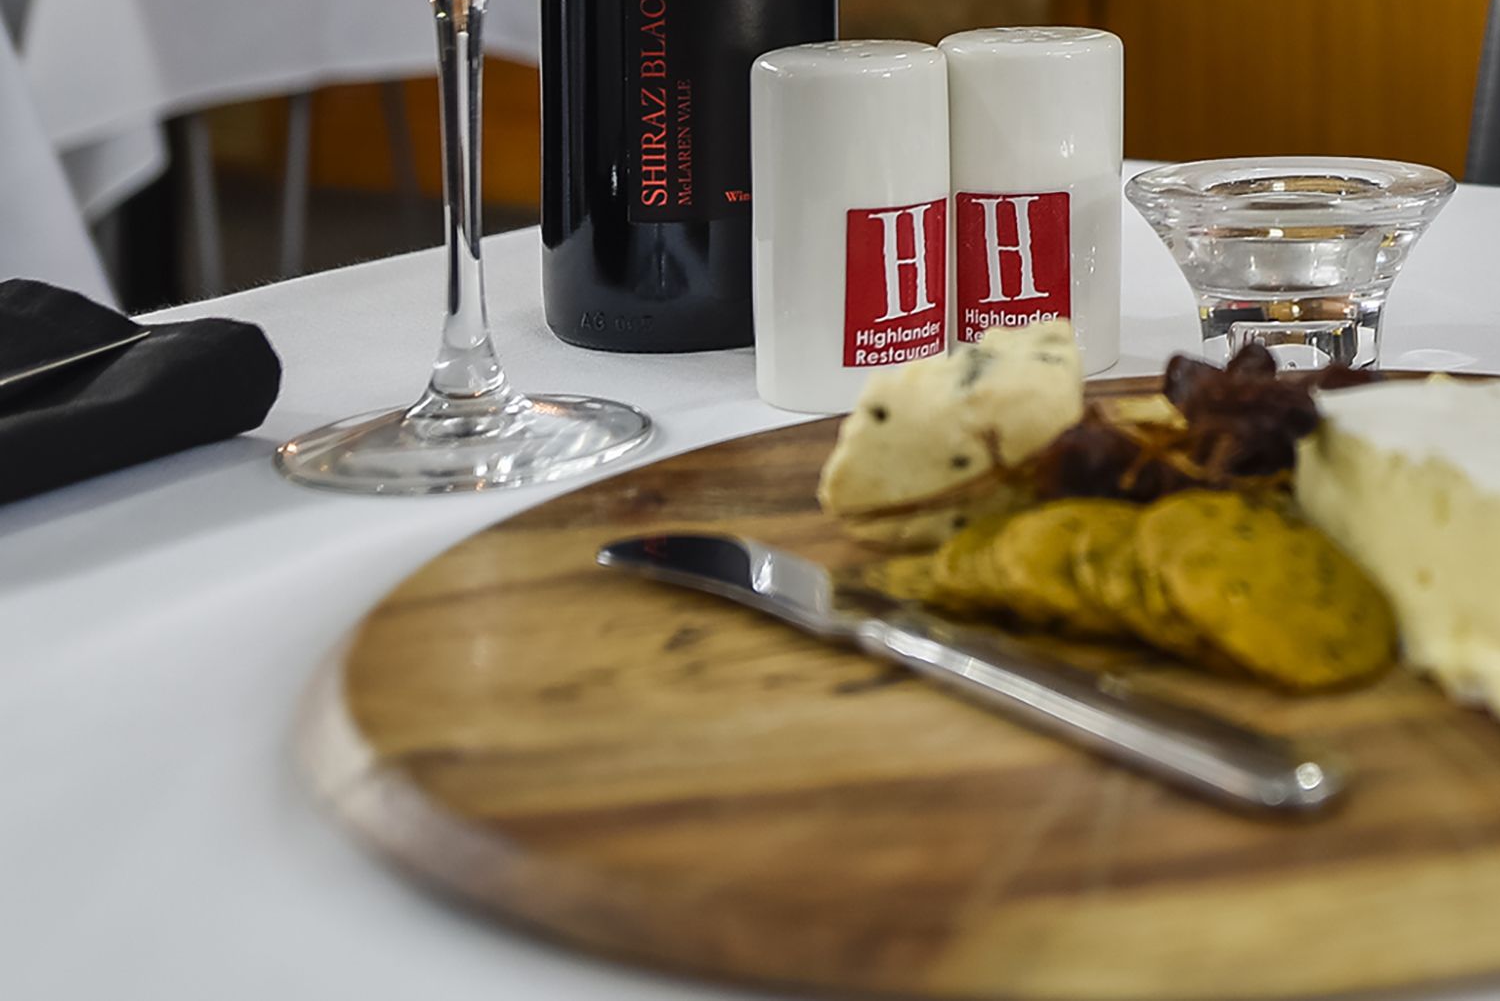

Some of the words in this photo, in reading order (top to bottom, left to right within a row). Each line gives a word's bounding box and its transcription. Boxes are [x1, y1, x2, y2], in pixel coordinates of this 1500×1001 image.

[677, 79, 692, 122] VALE
[641, 88, 668, 206] SHIRAZ
[677, 126, 692, 205] McLAREN
[868, 204, 937, 323] H
[971, 196, 1049, 303] H
[856, 320, 941, 349] Highlander
[965, 308, 1060, 329] Highlander
[855, 338, 941, 366] Restaurant
